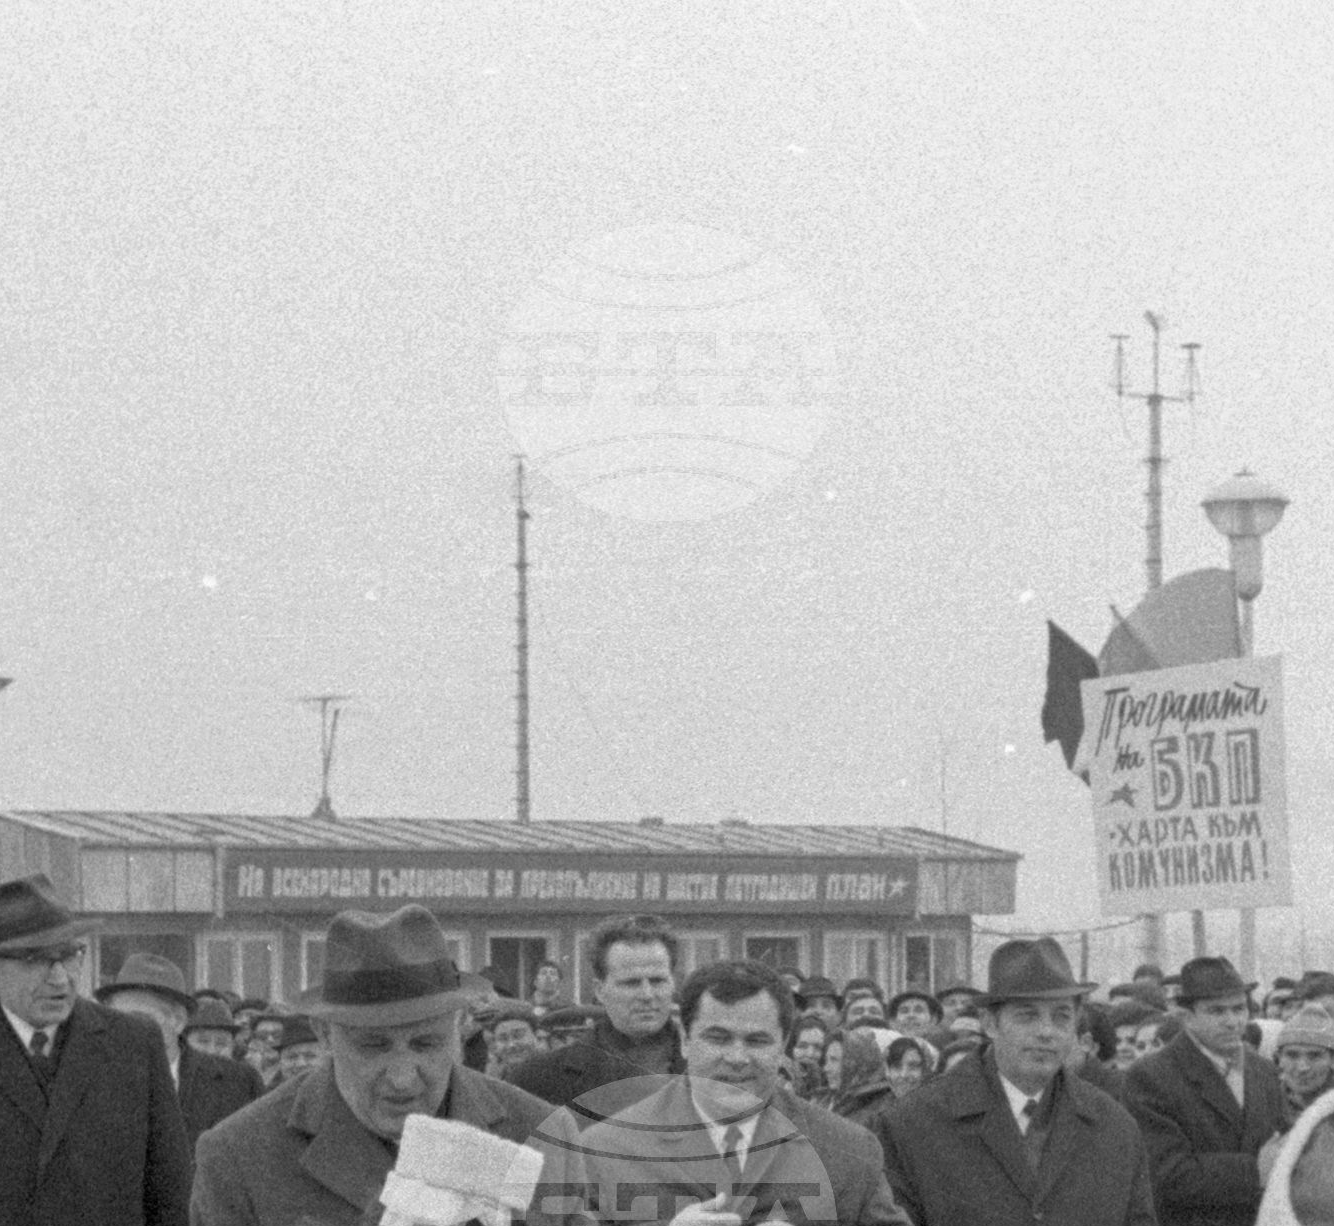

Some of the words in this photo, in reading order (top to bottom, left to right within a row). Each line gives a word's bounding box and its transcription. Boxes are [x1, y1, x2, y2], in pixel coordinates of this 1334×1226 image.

[1095, 681, 1268, 757] Програмата
[1113, 745, 1144, 773] на
[1151, 728, 1261, 811] БКП
[1108, 839, 1269, 891] КОМУНИЗМА!
